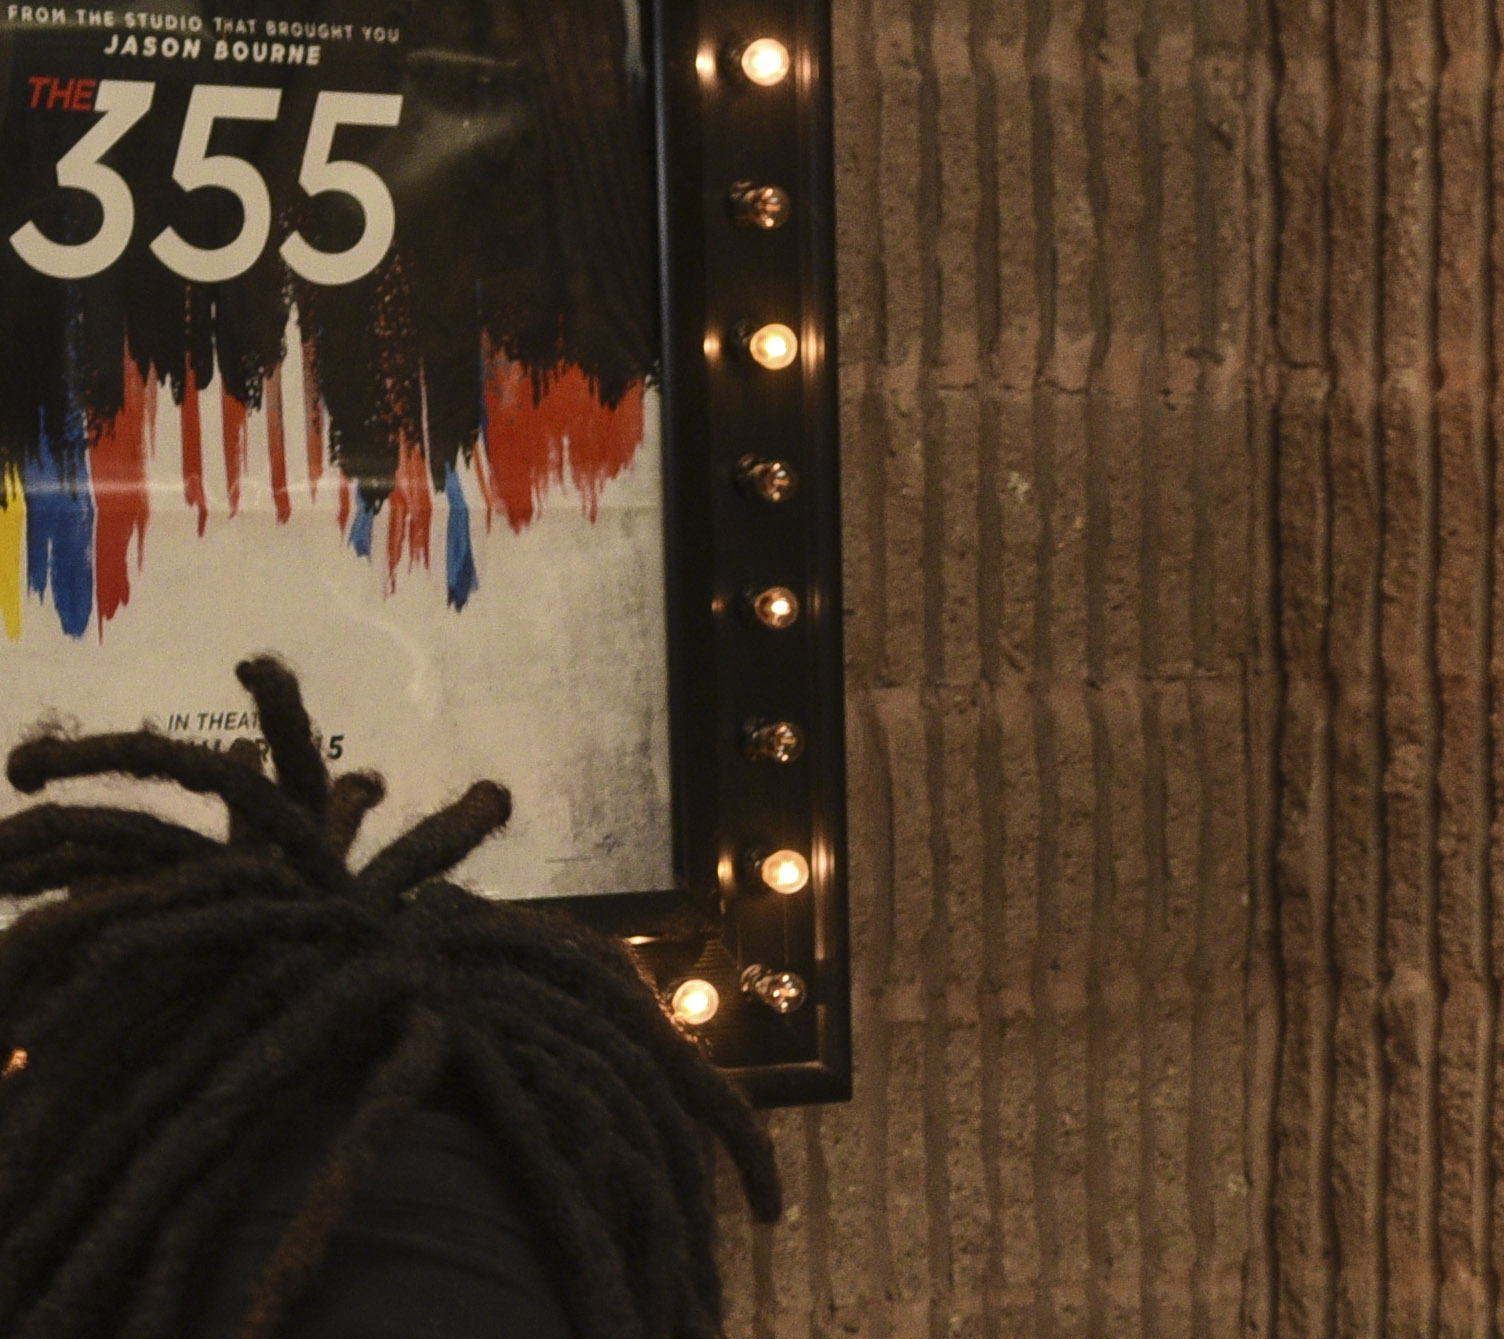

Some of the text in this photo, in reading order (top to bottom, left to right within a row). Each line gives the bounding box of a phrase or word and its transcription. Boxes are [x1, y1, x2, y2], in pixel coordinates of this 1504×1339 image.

[8, 5, 400, 43] FROM THE STUDIO THAT BROUGHT YOU
[104, 35, 321, 66] JASON BOURNE
[9, 76, 403, 287] THE 355
[168, 712, 262, 731] IN THEAT
